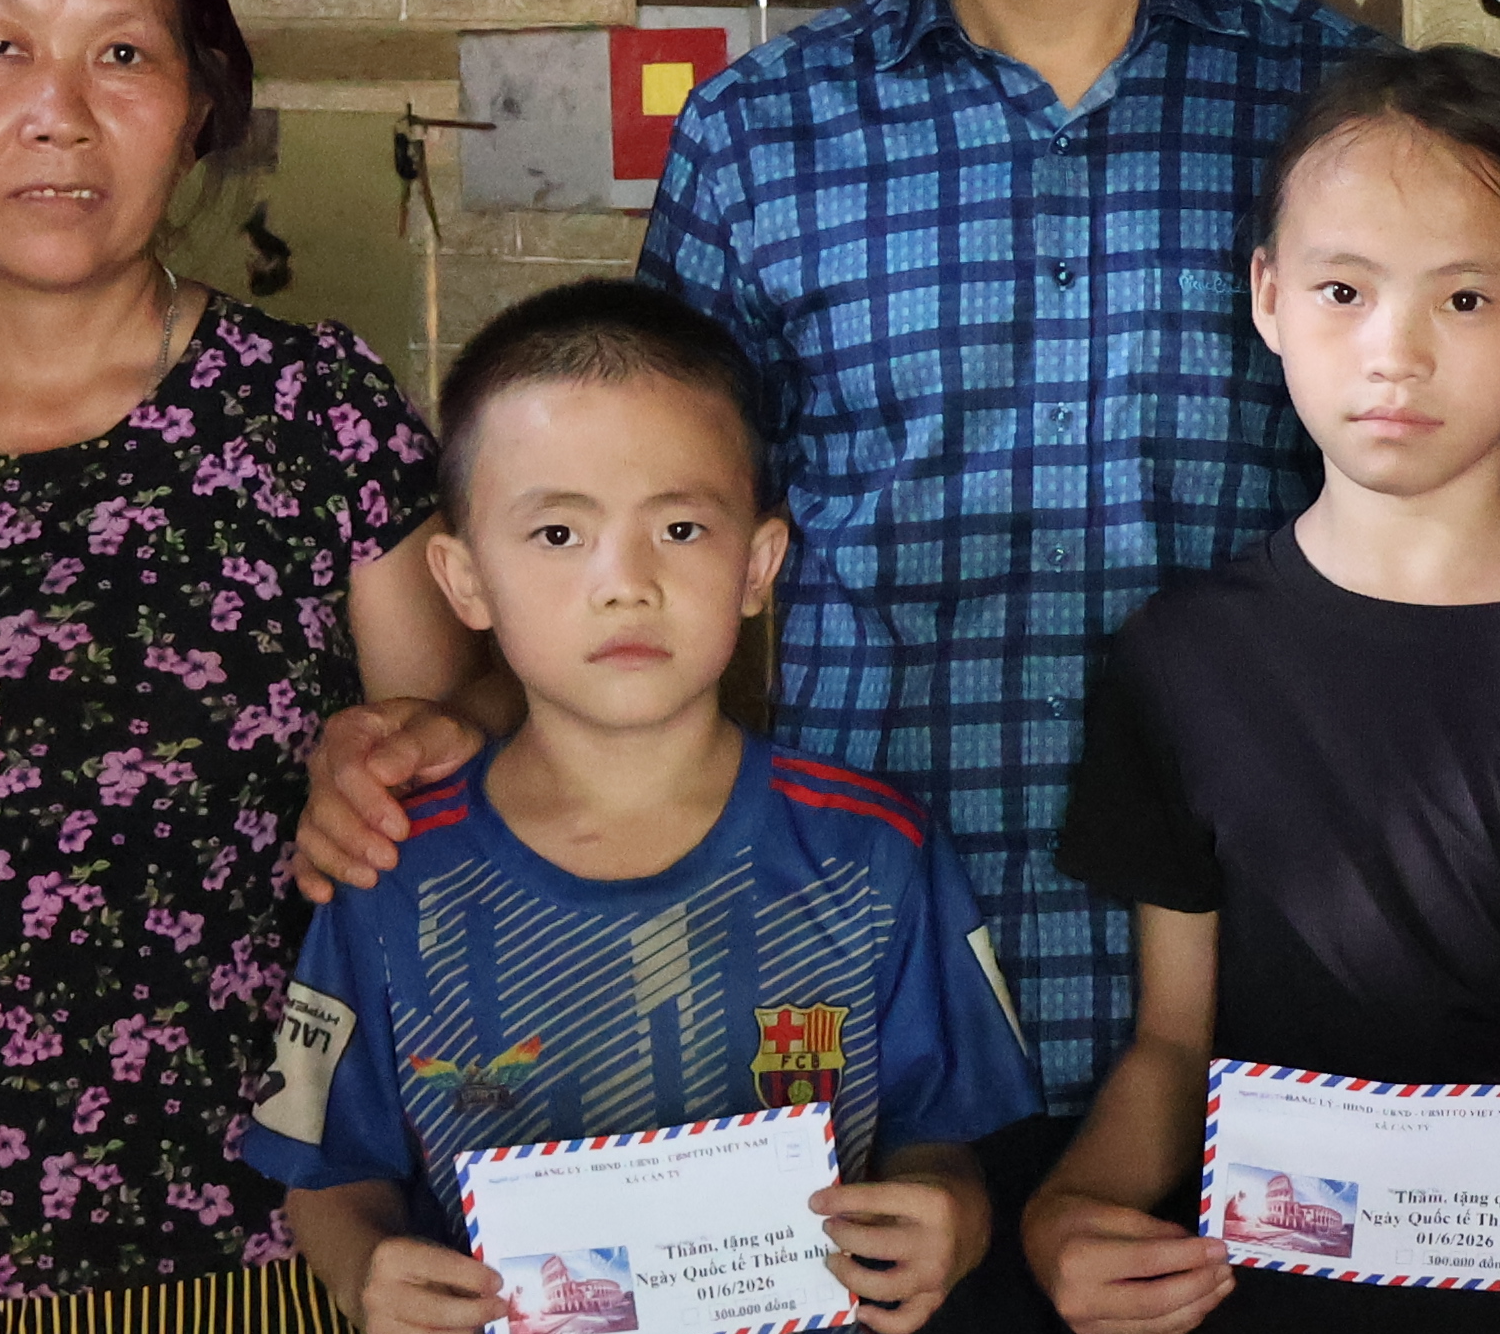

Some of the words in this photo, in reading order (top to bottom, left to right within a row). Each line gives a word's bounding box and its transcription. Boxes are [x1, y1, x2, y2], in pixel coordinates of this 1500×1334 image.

[780, 1054, 819, 1069] FCB
[1453, 1191, 1489, 1207] tặng
[1361, 1209, 1401, 1228] Ngày
[1408, 1208, 1451, 1227] Quốc
[1456, 1209, 1470, 1225] tế
[724, 1233, 759, 1252] tặng
[765, 1225, 795, 1243] quà
[1416, 1232, 1494, 1248] 01/6/2026
[635, 1269, 677, 1289] Ngày
[683, 1258, 727, 1282] Quốc
[731, 1253, 747, 1271] tế
[751, 1245, 799, 1268] Thiếu
[804, 1243, 830, 1260] nhi
[697, 1275, 775, 1301] 01/6/2026
